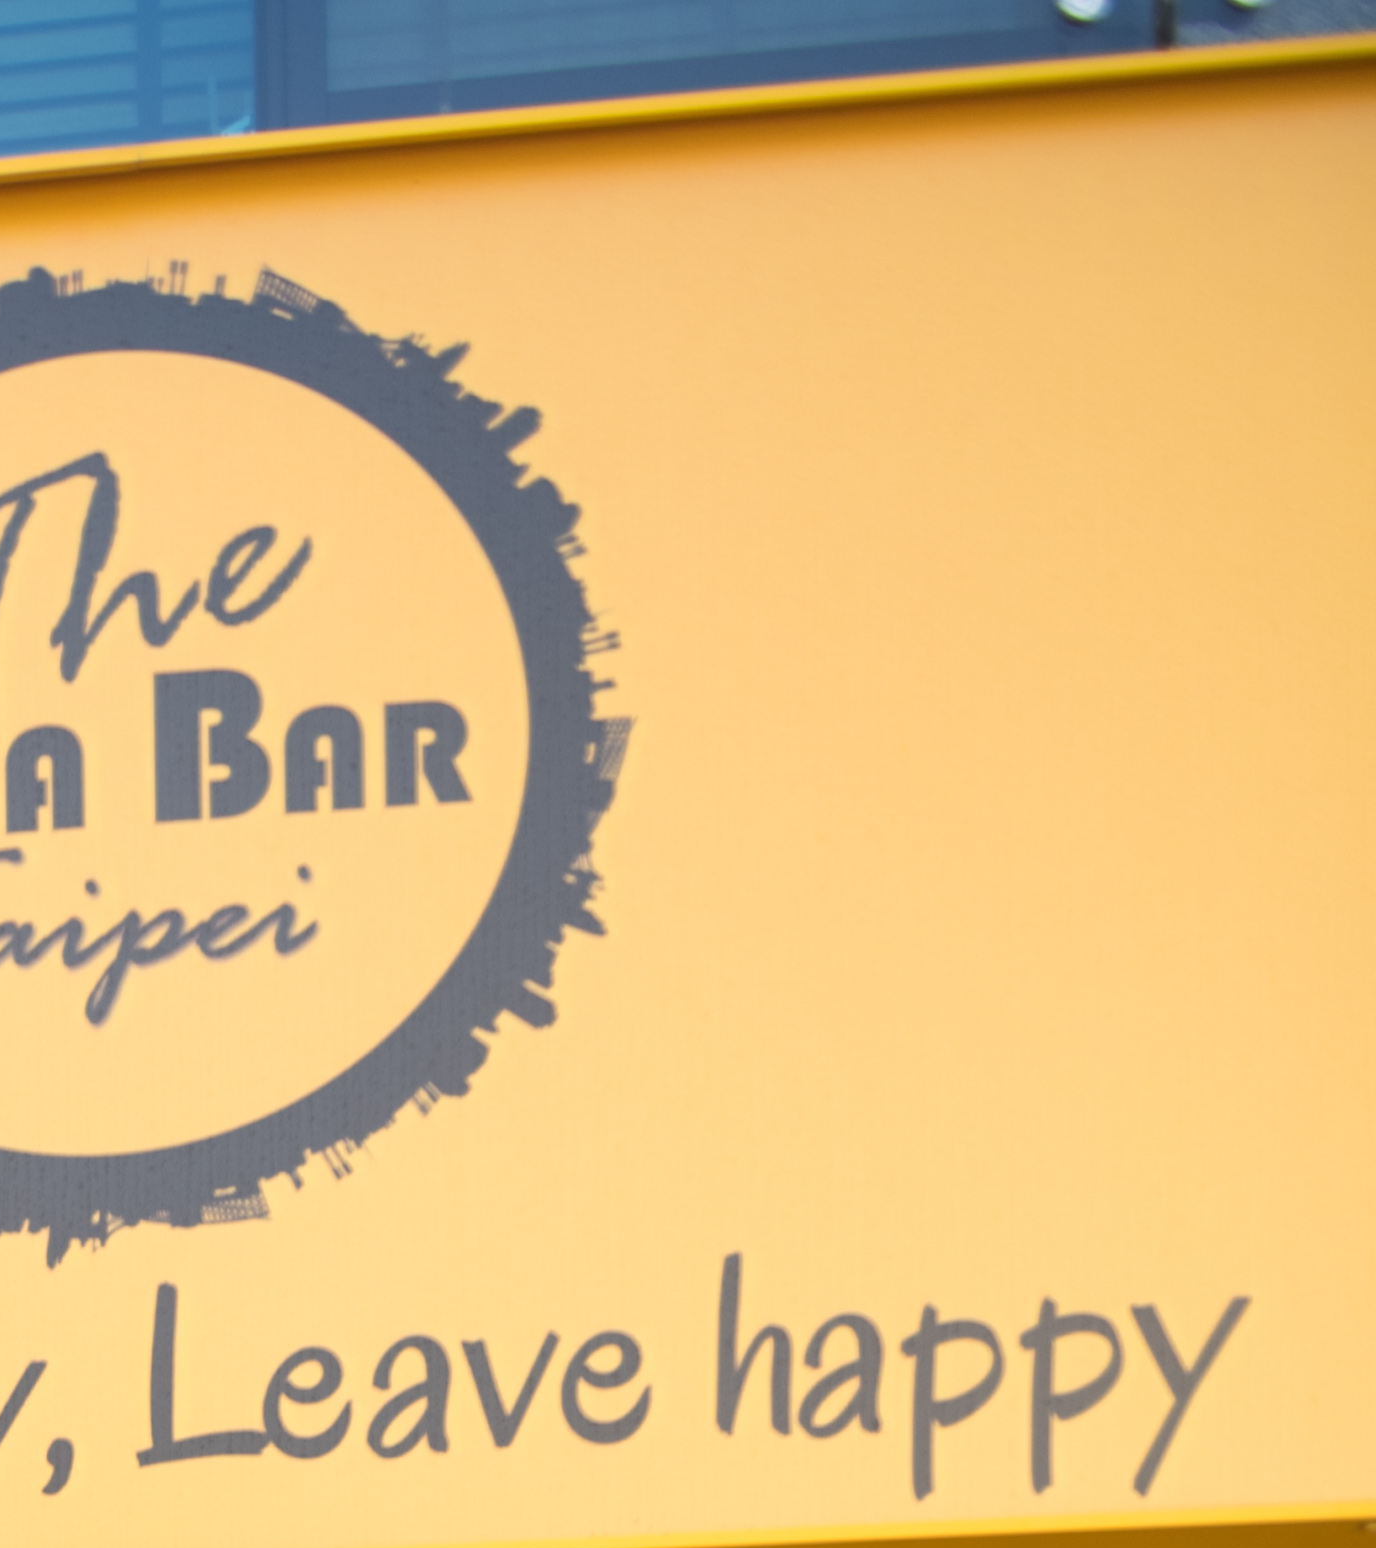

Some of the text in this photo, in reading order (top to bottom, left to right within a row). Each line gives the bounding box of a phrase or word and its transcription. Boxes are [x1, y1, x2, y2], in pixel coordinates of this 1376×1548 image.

[153, 668, 471, 823] BAR
[136, 1282, 650, 1467] Leave
[716, 1253, 1249, 1500] happy
